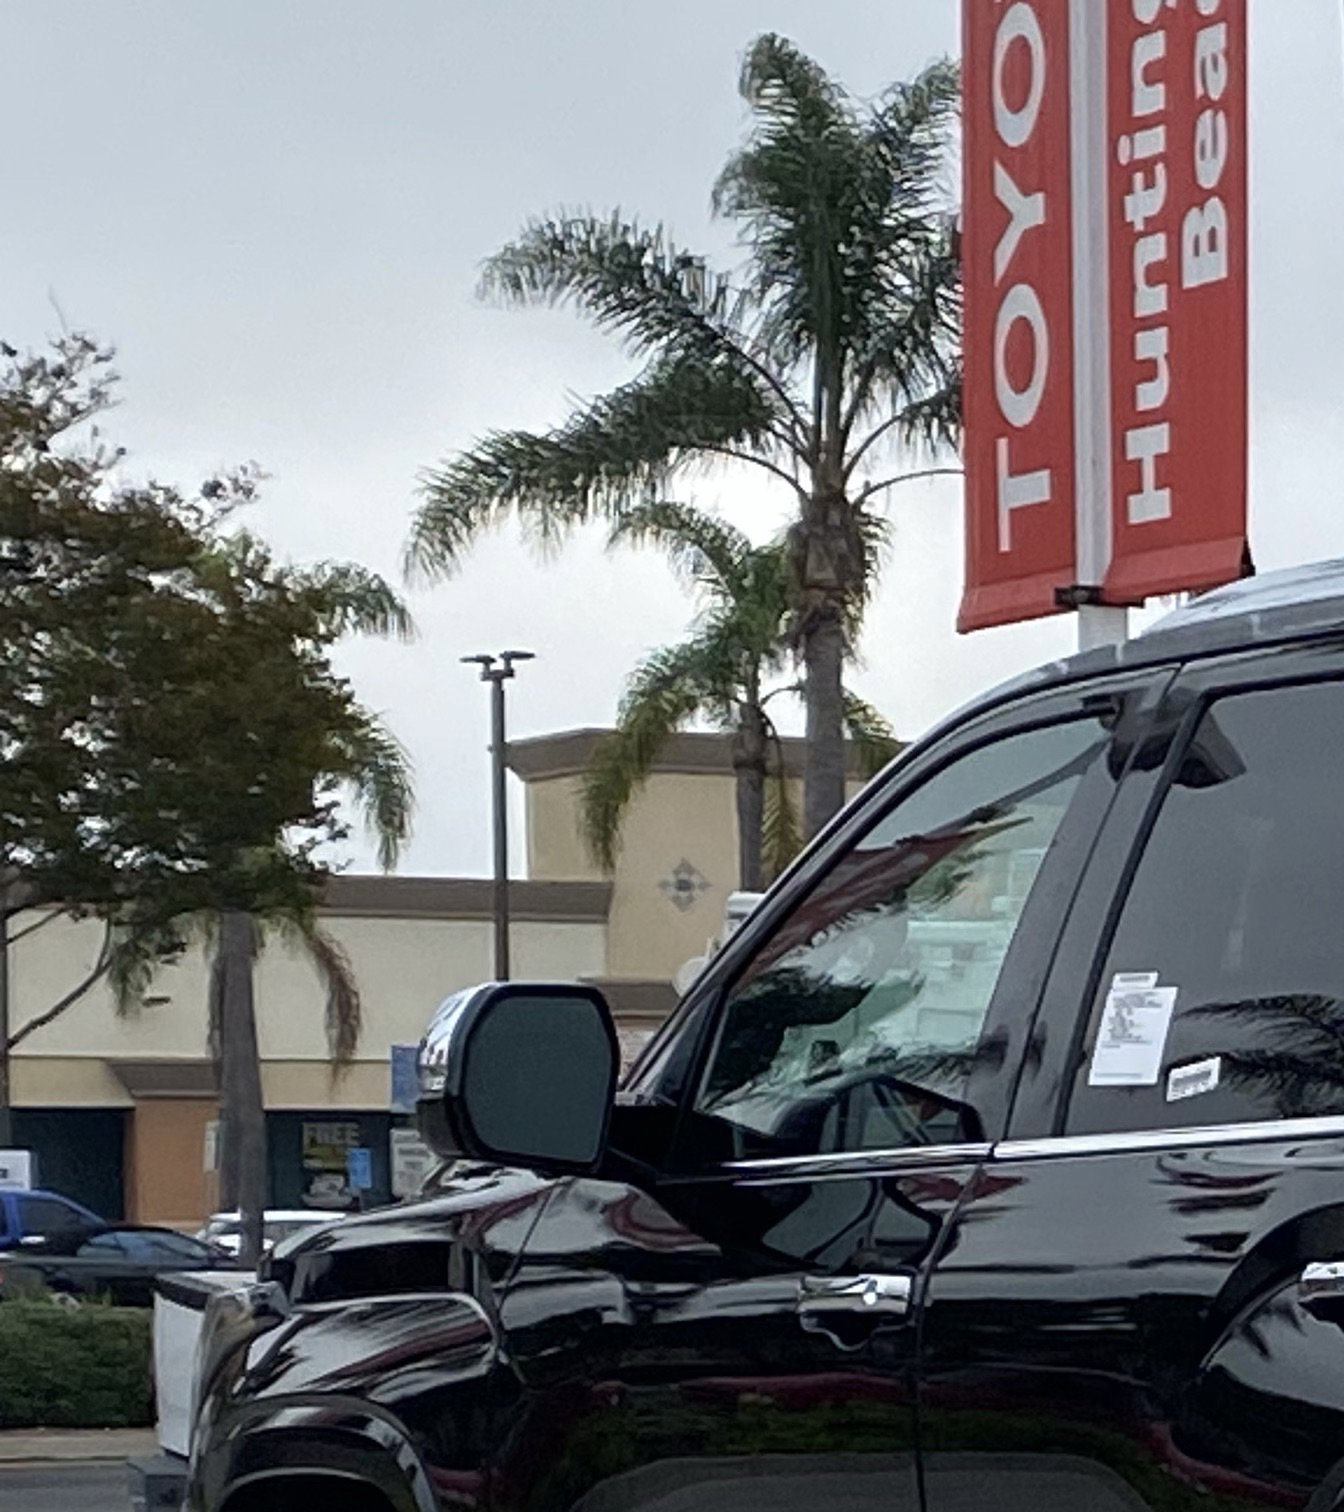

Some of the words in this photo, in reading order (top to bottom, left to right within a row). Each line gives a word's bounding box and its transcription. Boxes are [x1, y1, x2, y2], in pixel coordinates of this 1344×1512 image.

[993, 0, 1051, 552] TOYO
[1117, 0, 1176, 525] Huntin
[1182, 0, 1229, 289] Bea
